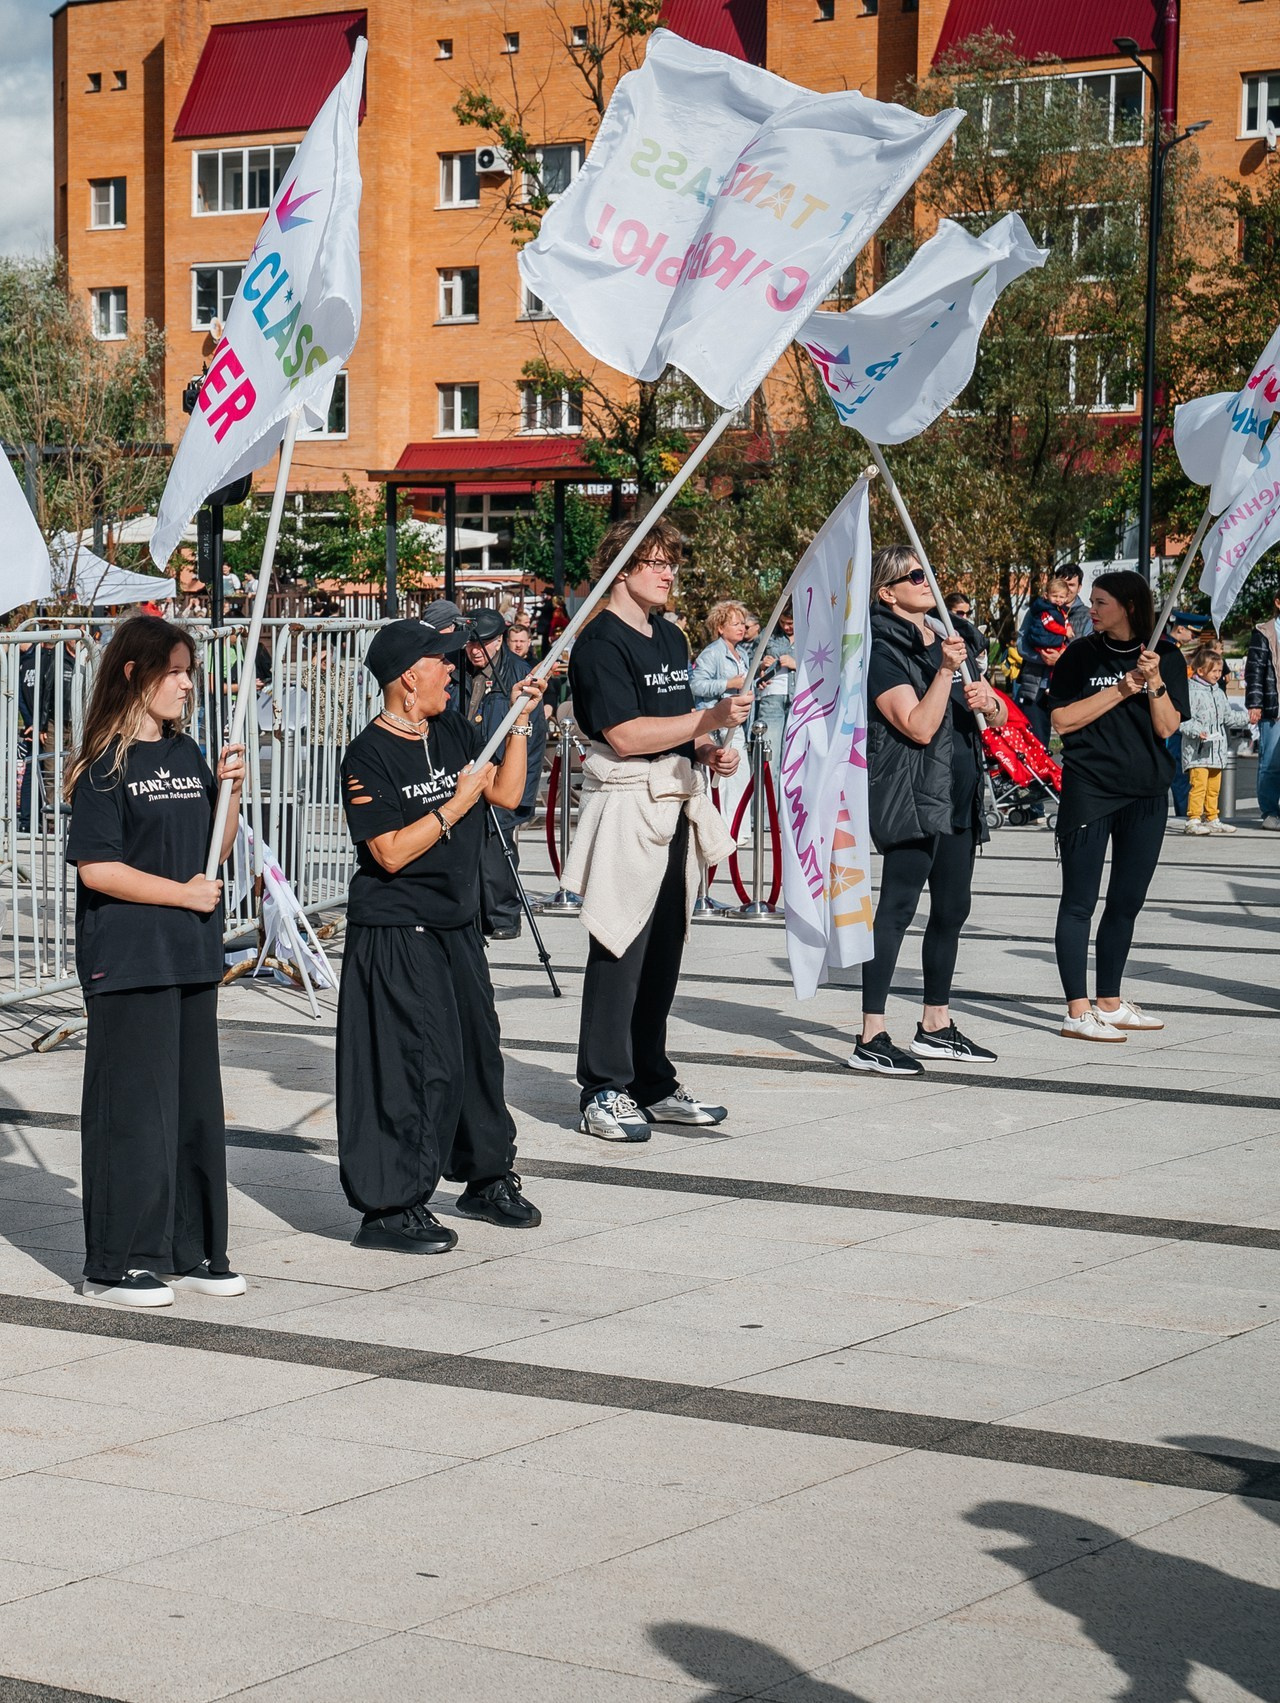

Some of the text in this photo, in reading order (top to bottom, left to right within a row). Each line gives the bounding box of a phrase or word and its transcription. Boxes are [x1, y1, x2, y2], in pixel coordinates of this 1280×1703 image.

[1089, 676, 1119, 687] TANZ
[128, 779, 166, 797] TANZ
[401, 781, 441, 799] TANZ
